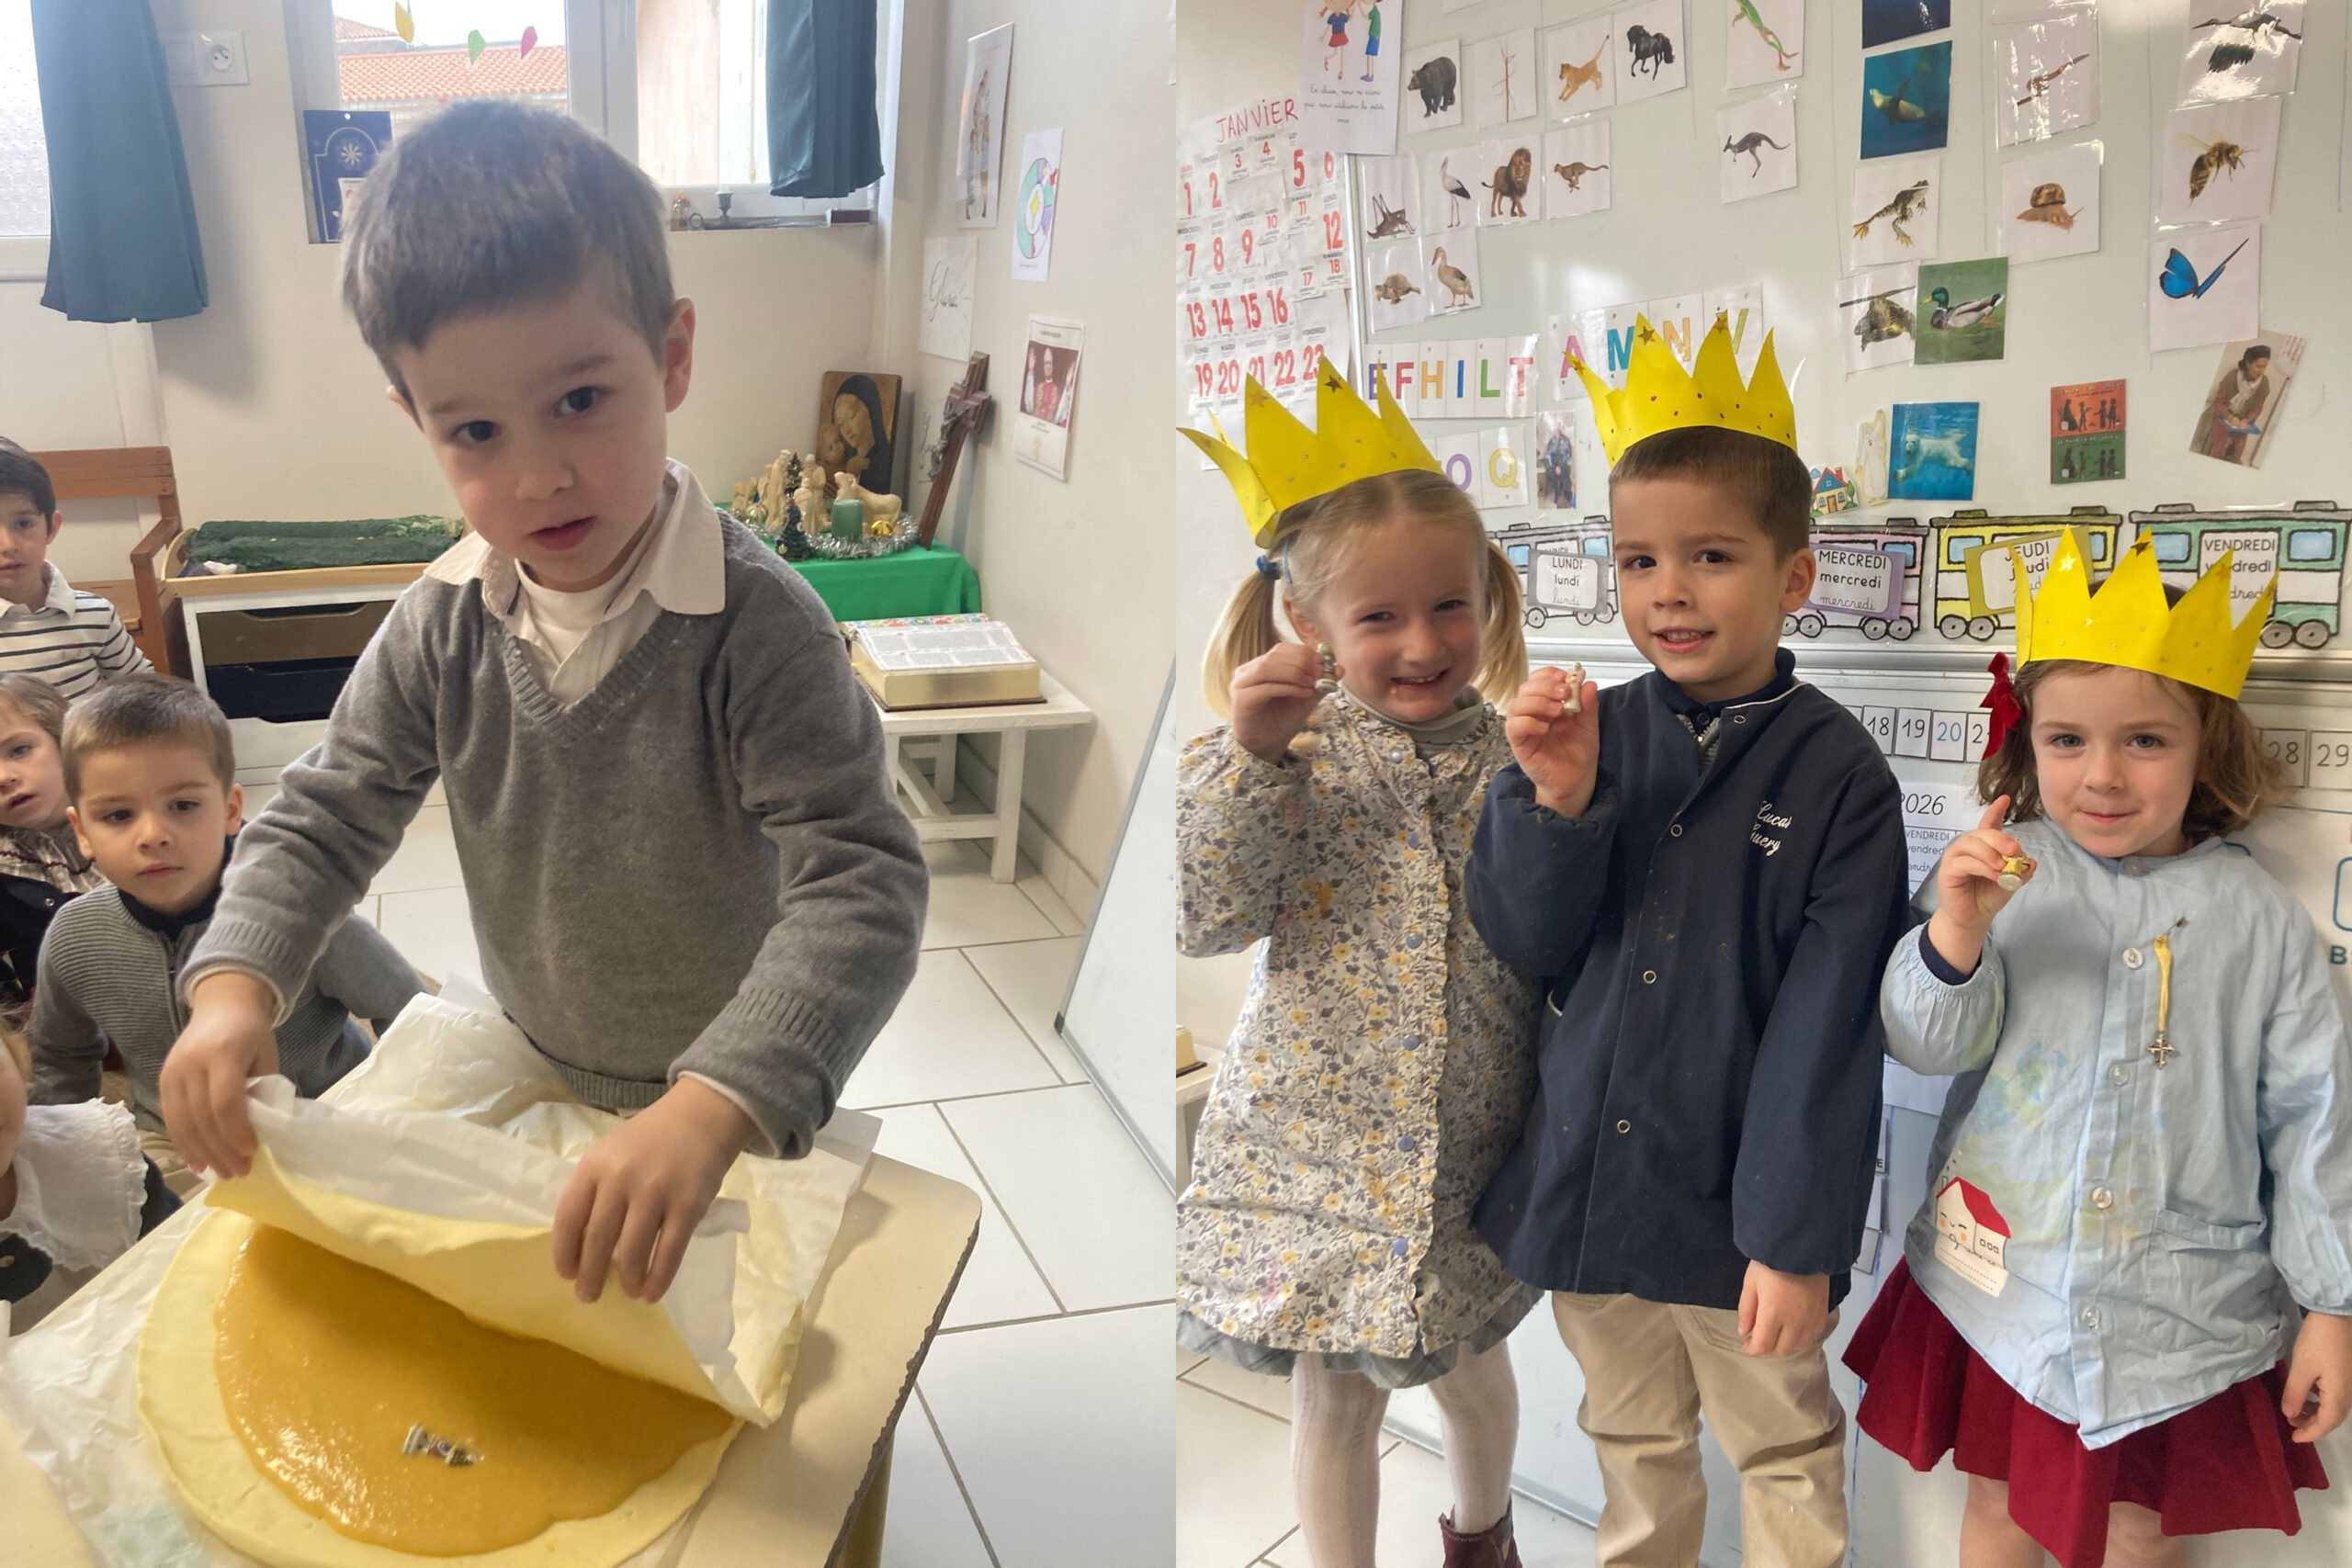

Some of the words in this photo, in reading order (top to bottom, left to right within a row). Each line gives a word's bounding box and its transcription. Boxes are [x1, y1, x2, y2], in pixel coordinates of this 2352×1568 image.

[1235, 153, 1242, 168] 3
[1262, 141, 1272, 156] 4
[1294, 149, 1306, 186] 5
[1183, 182, 1193, 216] 1
[1209, 172, 1222, 209] 2
[1266, 214, 1278, 230] 10
[1323, 210, 1343, 250] 12
[1185, 243, 1196, 277] 7
[1213, 236, 1224, 273] 8
[1241, 229, 1253, 265] 9
[1303, 271, 1313, 286] 17
[1329, 258, 1340, 274] 18
[1186, 301, 1206, 338] 13
[1212, 298, 1234, 334] 14
[1240, 292, 1261, 330] 15
[1266, 287, 1288, 325] 16
[1303, 344, 1324, 380] 23
[1560, 335, 1586, 378] A
[1663, 317, 1691, 361] N
[1194, 363, 1213, 397] 19
[1218, 359, 1239, 395] 20
[1249, 355, 1265, 389] 21
[1274, 349, 1295, 386] 22
[1396, 362, 1414, 399] F
[1421, 360, 1443, 399] H
[1457, 360, 1464, 398] I
[1480, 359, 1500, 398] L
[1510, 356, 1533, 397] T
[1446, 453, 1472, 491] O
[1488, 448, 1519, 490] Q
[1819, 550, 1886, 570] MERCREDI
[2204, 539, 2275, 551] VENDREDI
[1553, 557, 1582, 570] LUNDI
[1555, 574, 1579, 586] lundi
[1820, 573, 1881, 588] mercredi
[1553, 588, 1580, 606] lundi
[1820, 596, 1876, 611] mercredi
[1867, 716, 1889, 735] 18
[1902, 718, 1925, 738] 19
[1937, 722, 1962, 741] 20
[1973, 724, 1987, 743] 2
[2268, 741, 2299, 764] 28
[2317, 744, 2349, 767] 29
[1757, 800, 1792, 829] Lucas
[1905, 830, 1949, 840] VENDREDI
